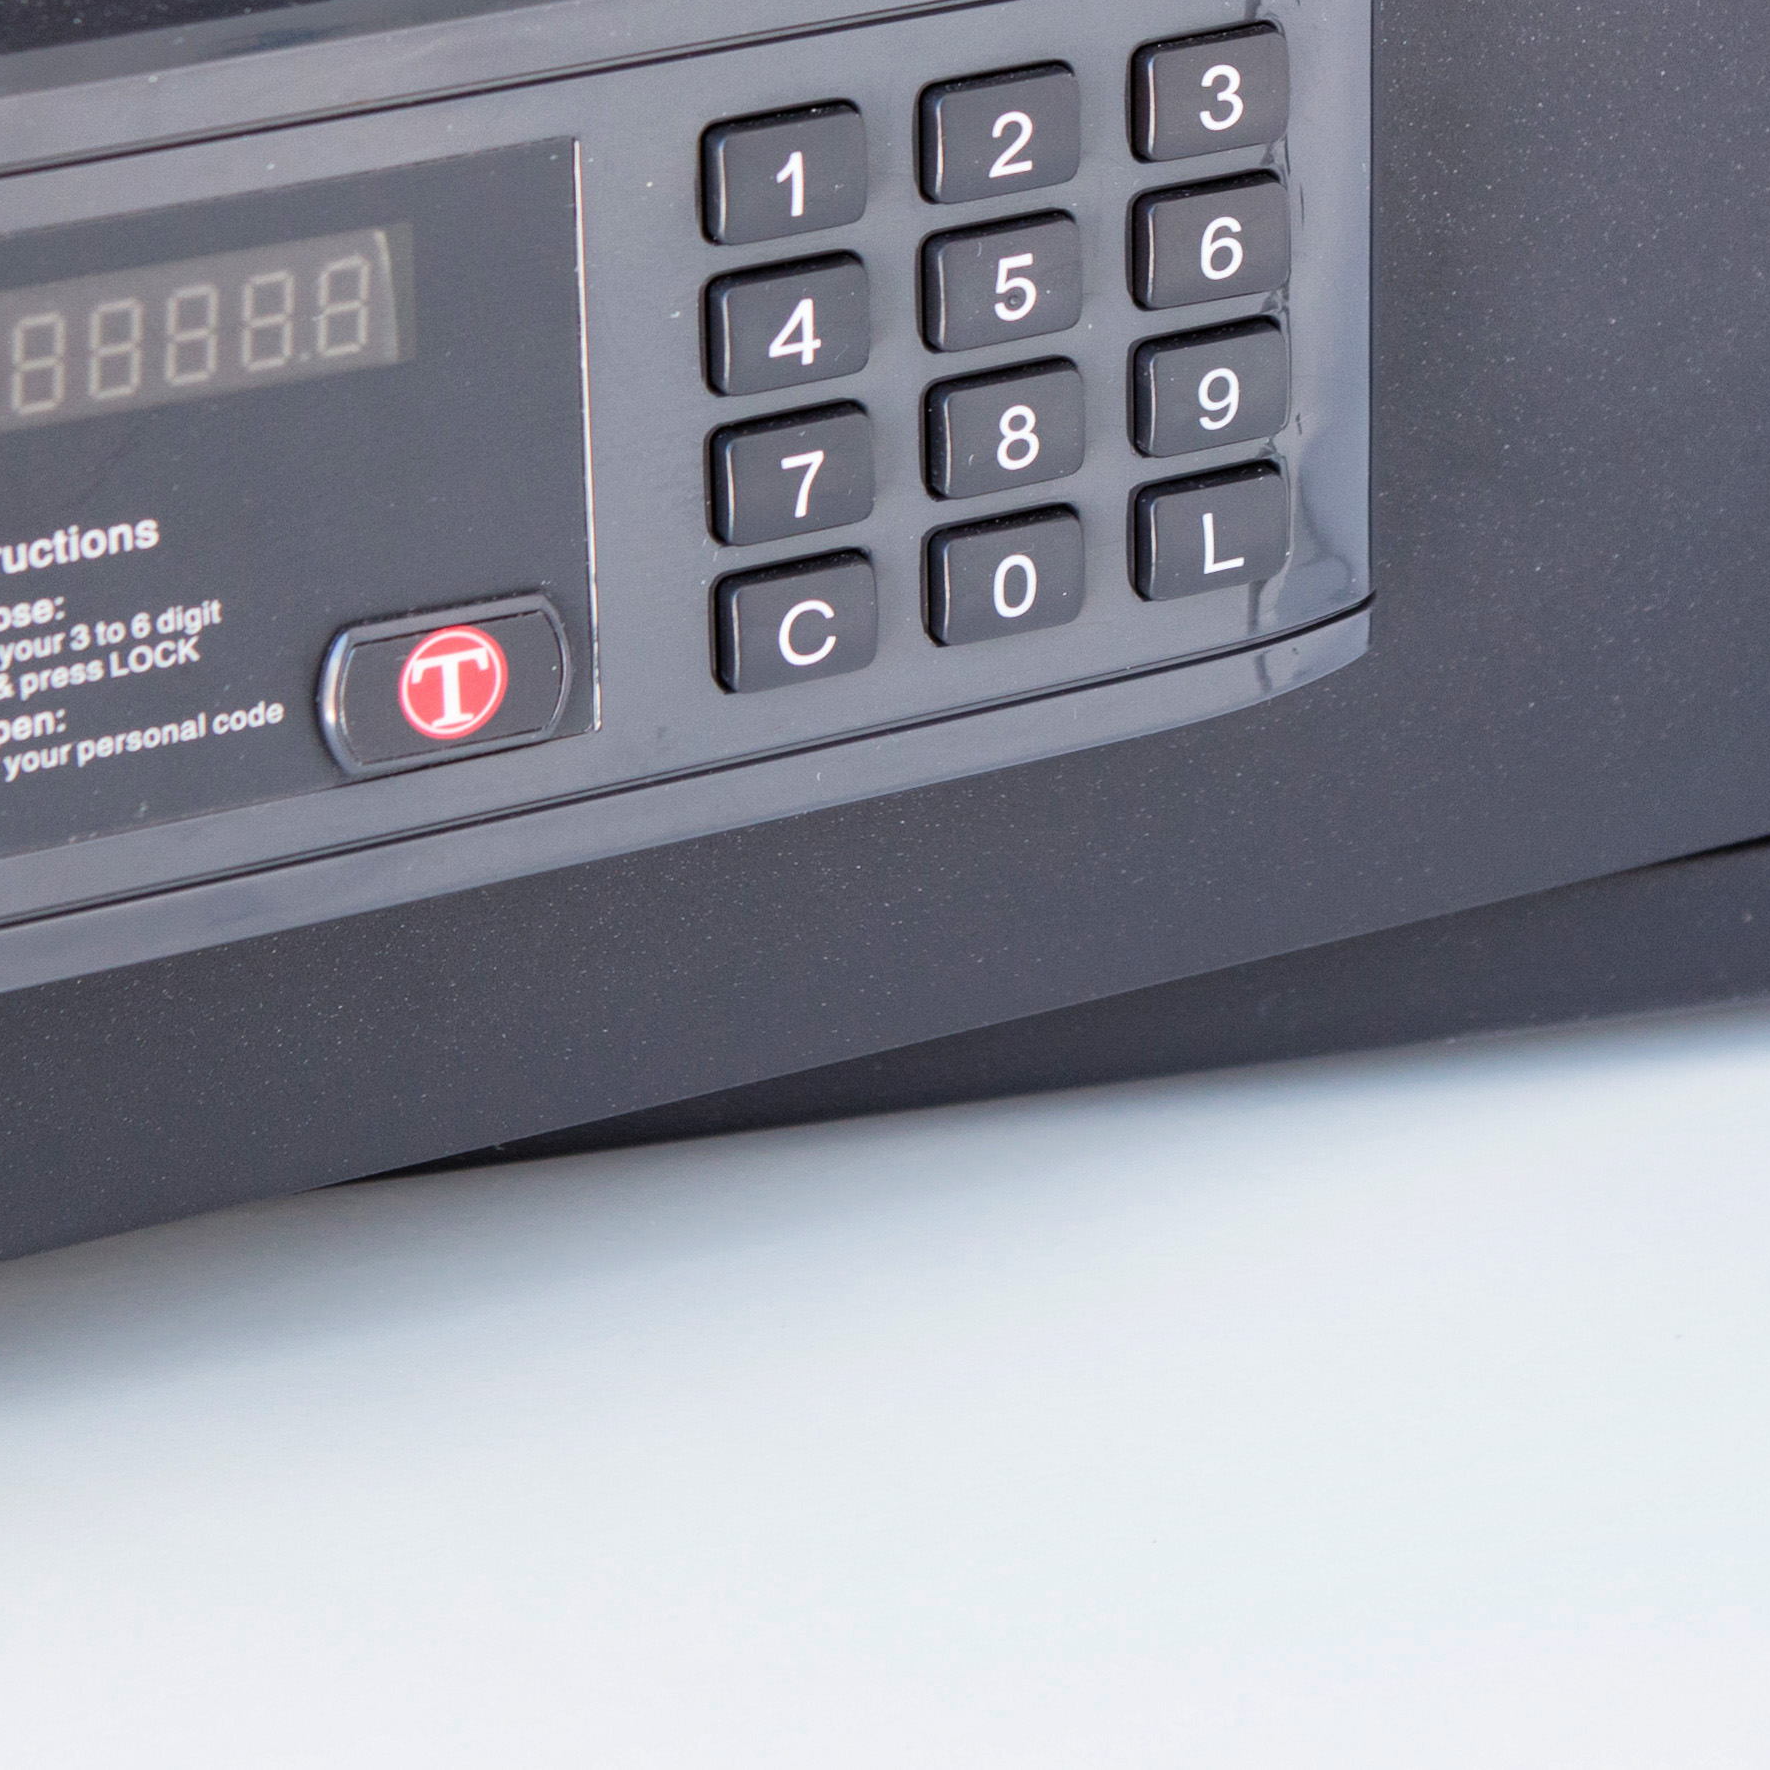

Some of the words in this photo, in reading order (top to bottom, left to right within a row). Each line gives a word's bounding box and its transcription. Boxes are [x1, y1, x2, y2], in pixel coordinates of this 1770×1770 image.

[1199, 64, 1244, 131] 3
[988, 110, 1033, 179] 2
[776, 151, 805, 217] 1
[1200, 216, 1244, 281] 6
[994, 252, 1037, 321] 5
[768, 297, 822, 366] 4
[1197, 367, 1241, 431] 9
[996, 404, 1040, 471] 8
[780, 449, 825, 519] 7
[1202, 512, 1245, 575] L
[993, 553, 1038, 618] 0
[69, 623, 92, 651] 3
[94, 620, 127, 647] to
[130, 611, 152, 640] 6
[155, 599, 222, 636] digit
[778, 599, 837, 666] C
[19, 659, 105, 701] press
[109, 635, 201, 678] LOCK
[2, 743, 73, 783] your
[76, 712, 207, 768] personal
[211, 700, 285, 735] code
